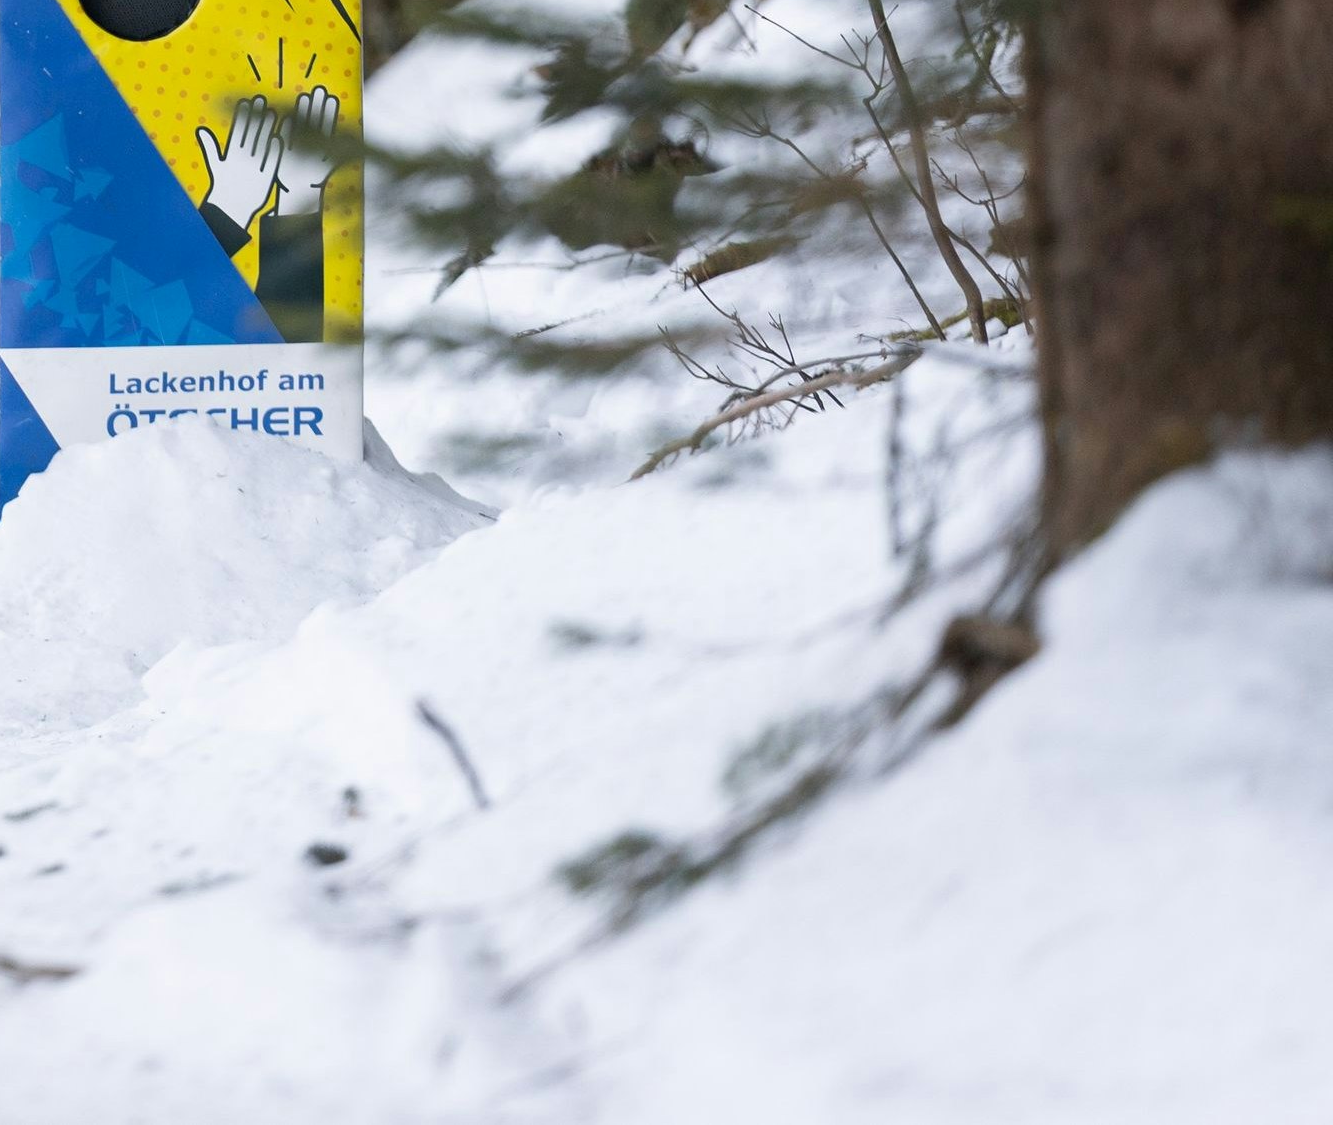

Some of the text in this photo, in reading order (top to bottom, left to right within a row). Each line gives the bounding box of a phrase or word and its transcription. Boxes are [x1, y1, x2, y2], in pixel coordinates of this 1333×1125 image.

[109, 369, 325, 394] Lackenhof am
[106, 403, 324, 438] ÖTHER
